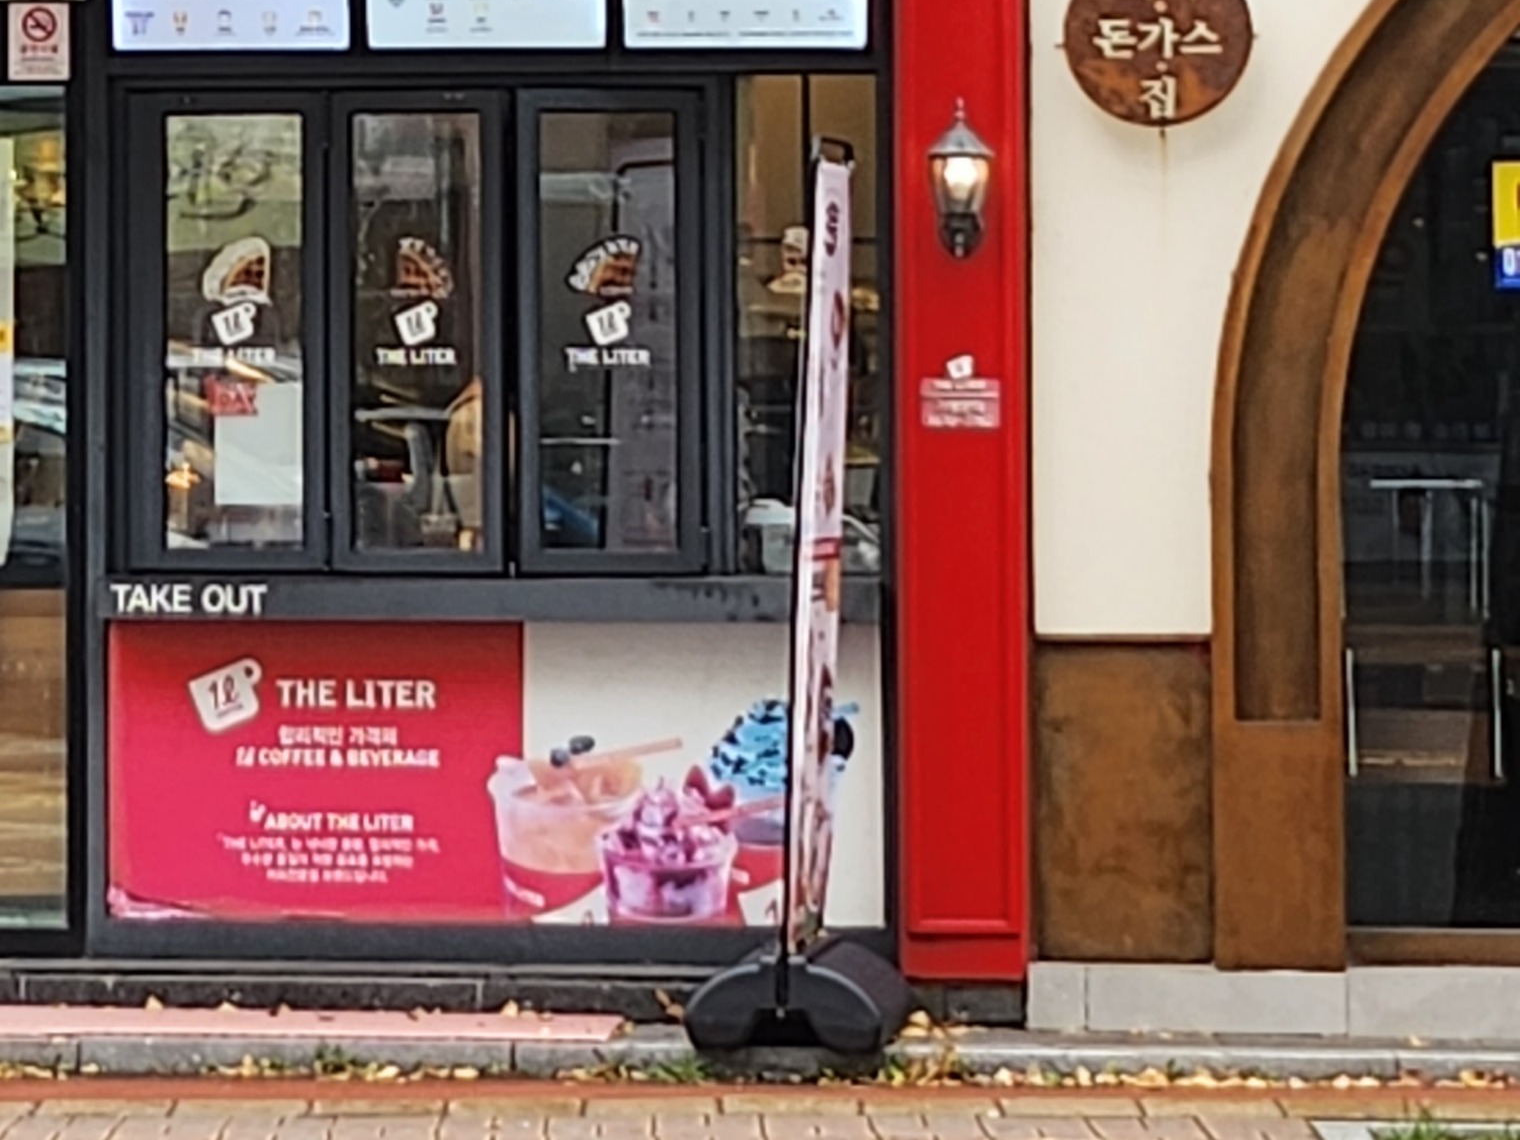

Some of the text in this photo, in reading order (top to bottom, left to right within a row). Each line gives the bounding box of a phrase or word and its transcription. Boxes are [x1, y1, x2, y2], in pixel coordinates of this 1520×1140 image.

[1092, 17, 1223, 59] 돈가스
[1138, 75, 1177, 118] 집
[410, 348, 456, 365] LITER
[602, 348, 650, 366] LITER
[111, 584, 267, 615] TAKE OUT
[276, 679, 437, 710] THE LITER
[258, 747, 326, 767] COFFEE
[346, 748, 441, 768] BEVERAGE
[264, 812, 414, 832] ABOUT THE LITER
